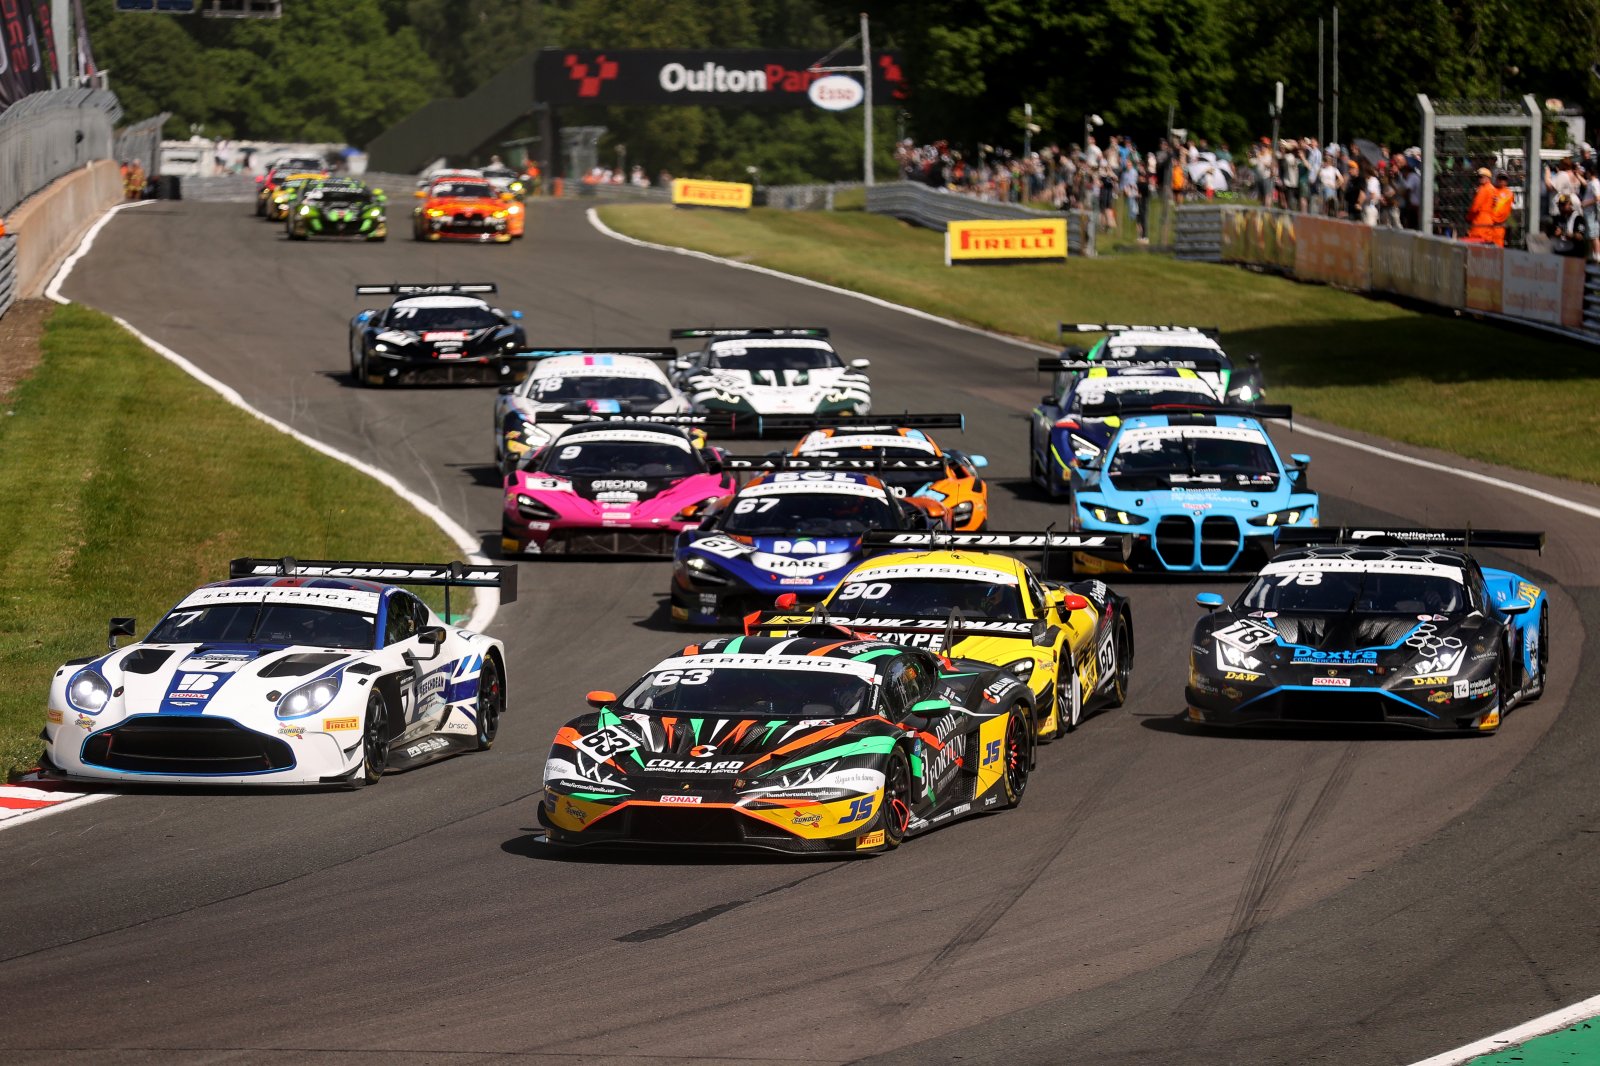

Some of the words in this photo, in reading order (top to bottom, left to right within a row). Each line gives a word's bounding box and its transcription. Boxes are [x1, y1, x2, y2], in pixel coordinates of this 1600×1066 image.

[960, 228, 1055, 250] PIRELLI
[536, 377, 563, 392] 18
[559, 446, 582, 459] 9
[1119, 438, 1163, 454] 44
[734, 498, 780, 514] 67
[701, 540, 740, 551] 67
[770, 560, 830, 568] HARE
[856, 567, 1005, 579] #BRITISHGT
[1275, 571, 1323, 586] 78
[203, 589, 356, 602] #BRITISHGT
[839, 583, 891, 601] 90
[167, 610, 204, 628] 7
[1224, 620, 1271, 645] 78
[1100, 640, 1114, 679] 90
[1294, 648, 1378, 659] Dextra
[203, 660, 230, 670] 7
[685, 657, 851, 669] #BRITISHGT
[652, 668, 712, 686] 63
[326, 718, 357, 730] PIRELLI
[935, 713, 957, 744] DAMA
[279, 727, 306, 735] SUNOCO
[582, 729, 631, 757] 63
[646, 758, 744, 770] COLLARD
[793, 815, 821, 824] SUNOCO
[860, 833, 884, 845] PIRELLI
